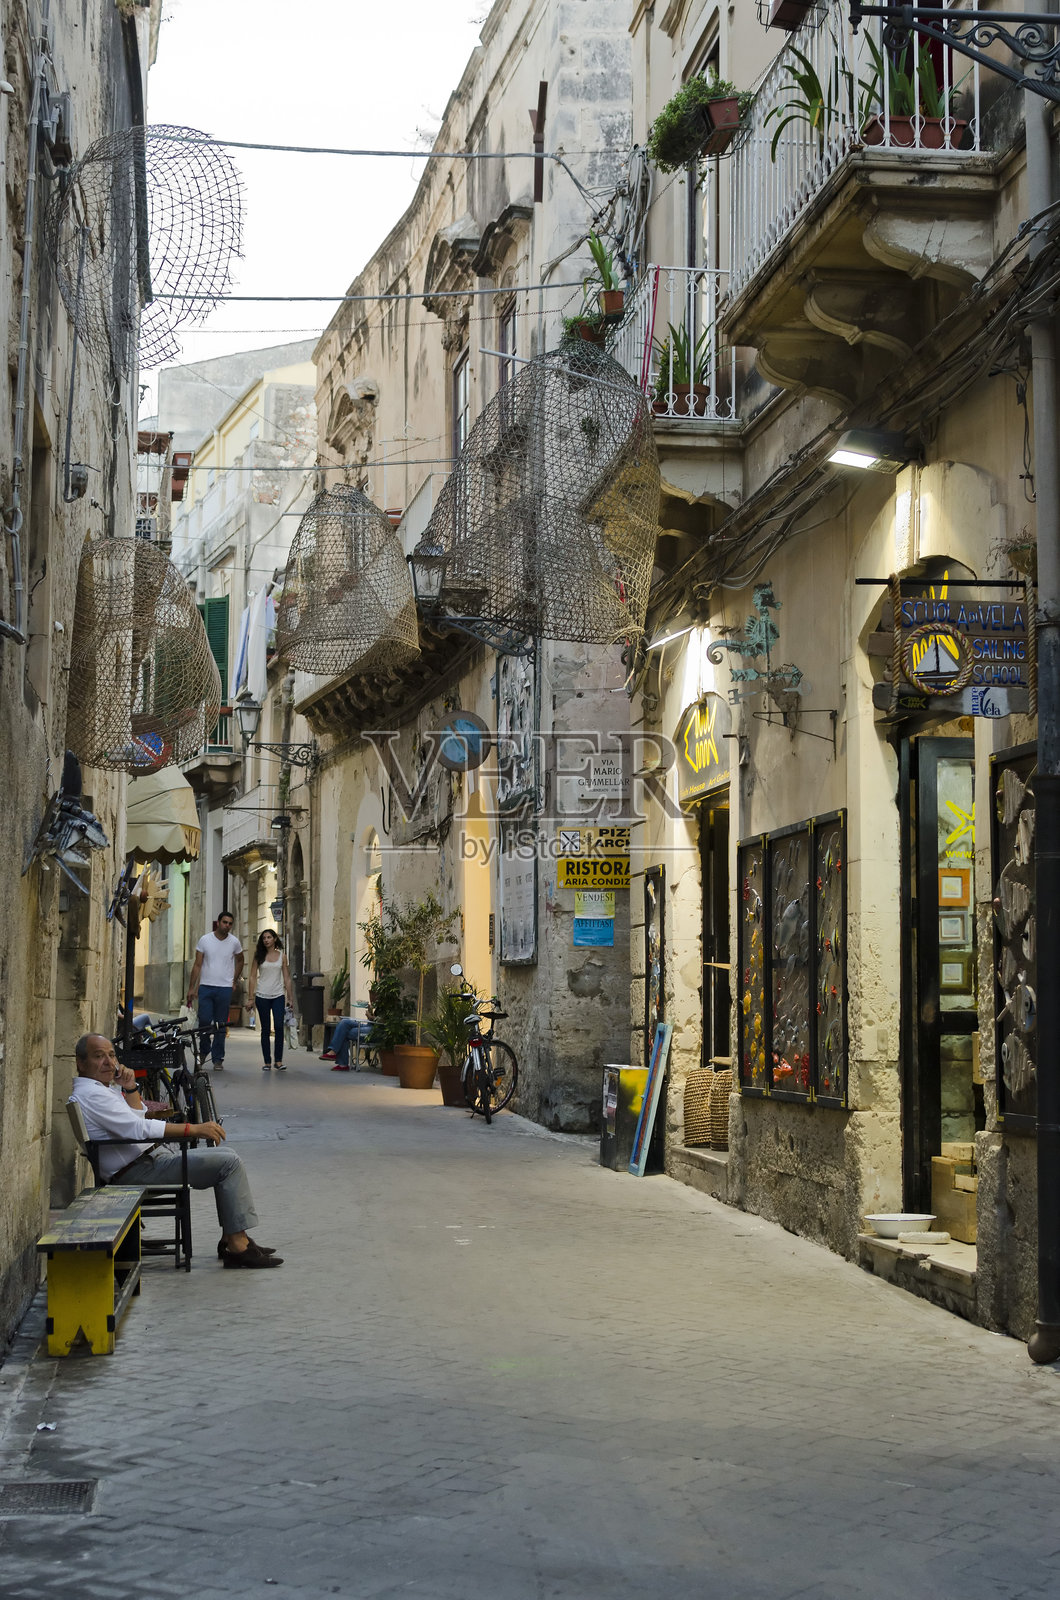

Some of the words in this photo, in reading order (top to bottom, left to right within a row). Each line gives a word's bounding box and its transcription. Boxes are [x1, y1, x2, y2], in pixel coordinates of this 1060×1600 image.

[901, 601, 969, 632] SCUOLA
[978, 605, 1025, 632] VELA
[972, 639, 1025, 660] SAILING
[972, 664, 1027, 685] SCHOOL
[971, 687, 980, 715] mare
[593, 767, 623, 776] MARIO
[599, 828, 630, 837] PIZ
[945, 850, 976, 859] www.
[576, 893, 613, 902] VENDESI
[575, 919, 612, 928] AFFITTASI
